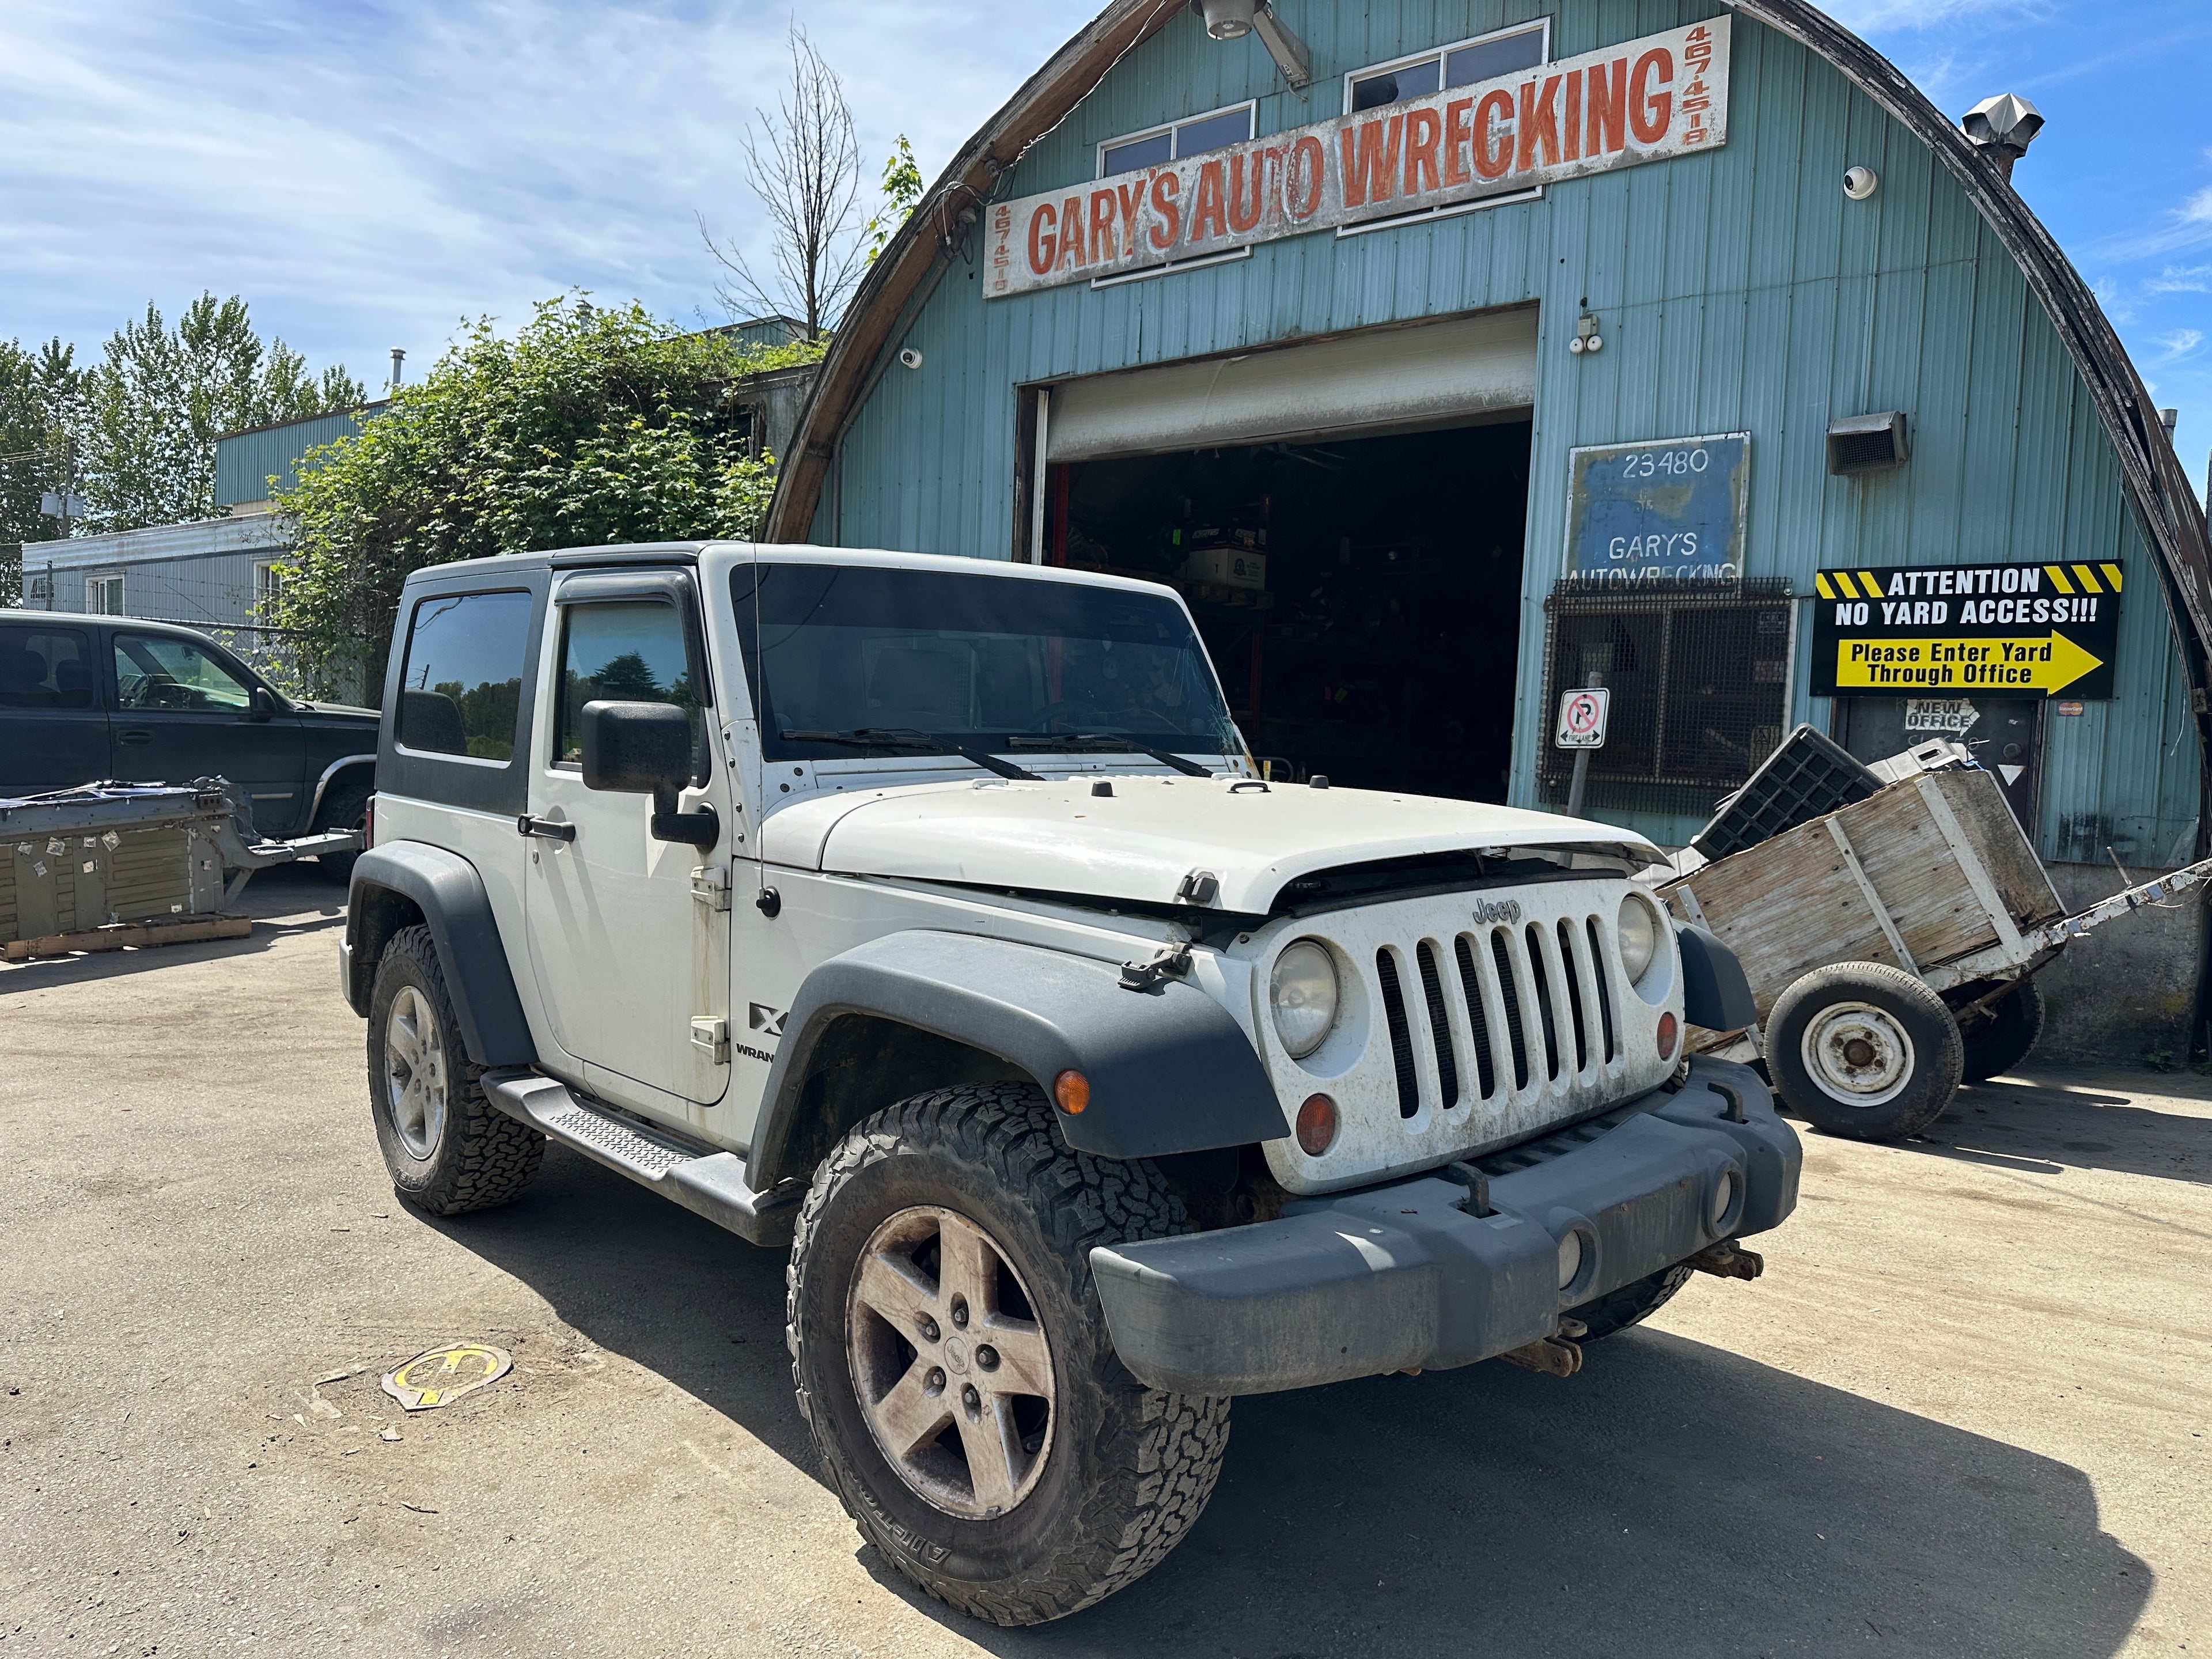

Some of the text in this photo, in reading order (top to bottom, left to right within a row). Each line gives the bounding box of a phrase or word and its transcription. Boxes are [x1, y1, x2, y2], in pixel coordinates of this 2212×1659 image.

[1027, 47, 1674, 275] GARY'S AUTO WRECKING
[1623, 448, 1709, 479] 23480
[1609, 532, 1698, 560] GARY'S
[1888, 567, 2040, 596] ATTENTION
[1835, 598, 2098, 626] NO YARD ACCESS!!!
[1851, 642, 2052, 662] Please Enter Yard
[1867, 663, 2032, 686] Through Office
[1907, 714, 1971, 728] OFFICE
[1917, 701, 1962, 714] NEW
[1472, 897, 1521, 924] Jeep
